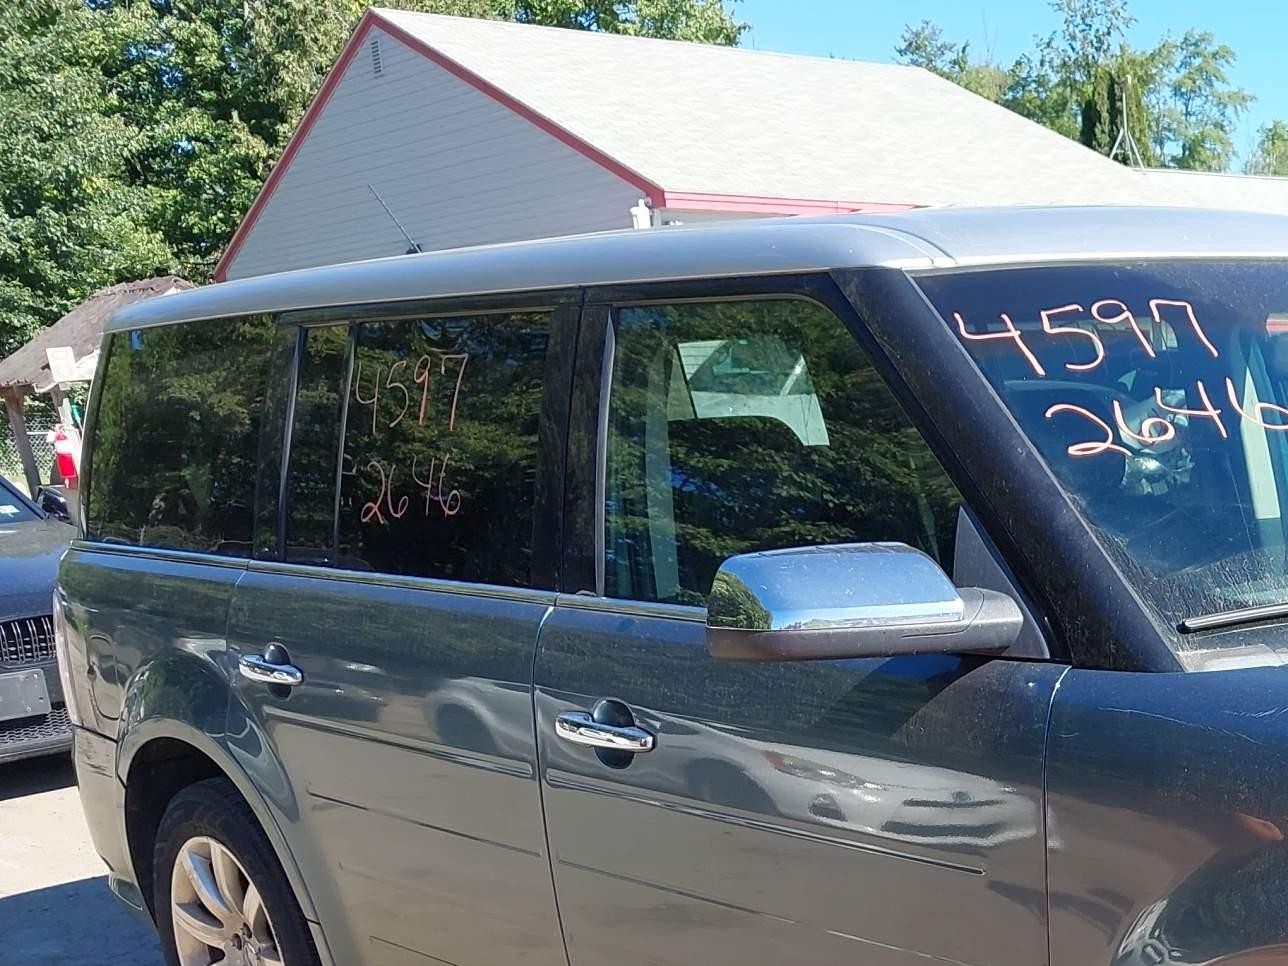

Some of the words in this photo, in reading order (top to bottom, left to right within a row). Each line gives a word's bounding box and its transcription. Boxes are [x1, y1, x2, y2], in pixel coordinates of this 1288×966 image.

[952, 297, 1219, 377] 4597
[355, 353, 469, 436] 4597
[360, 453, 462, 525] 2646
